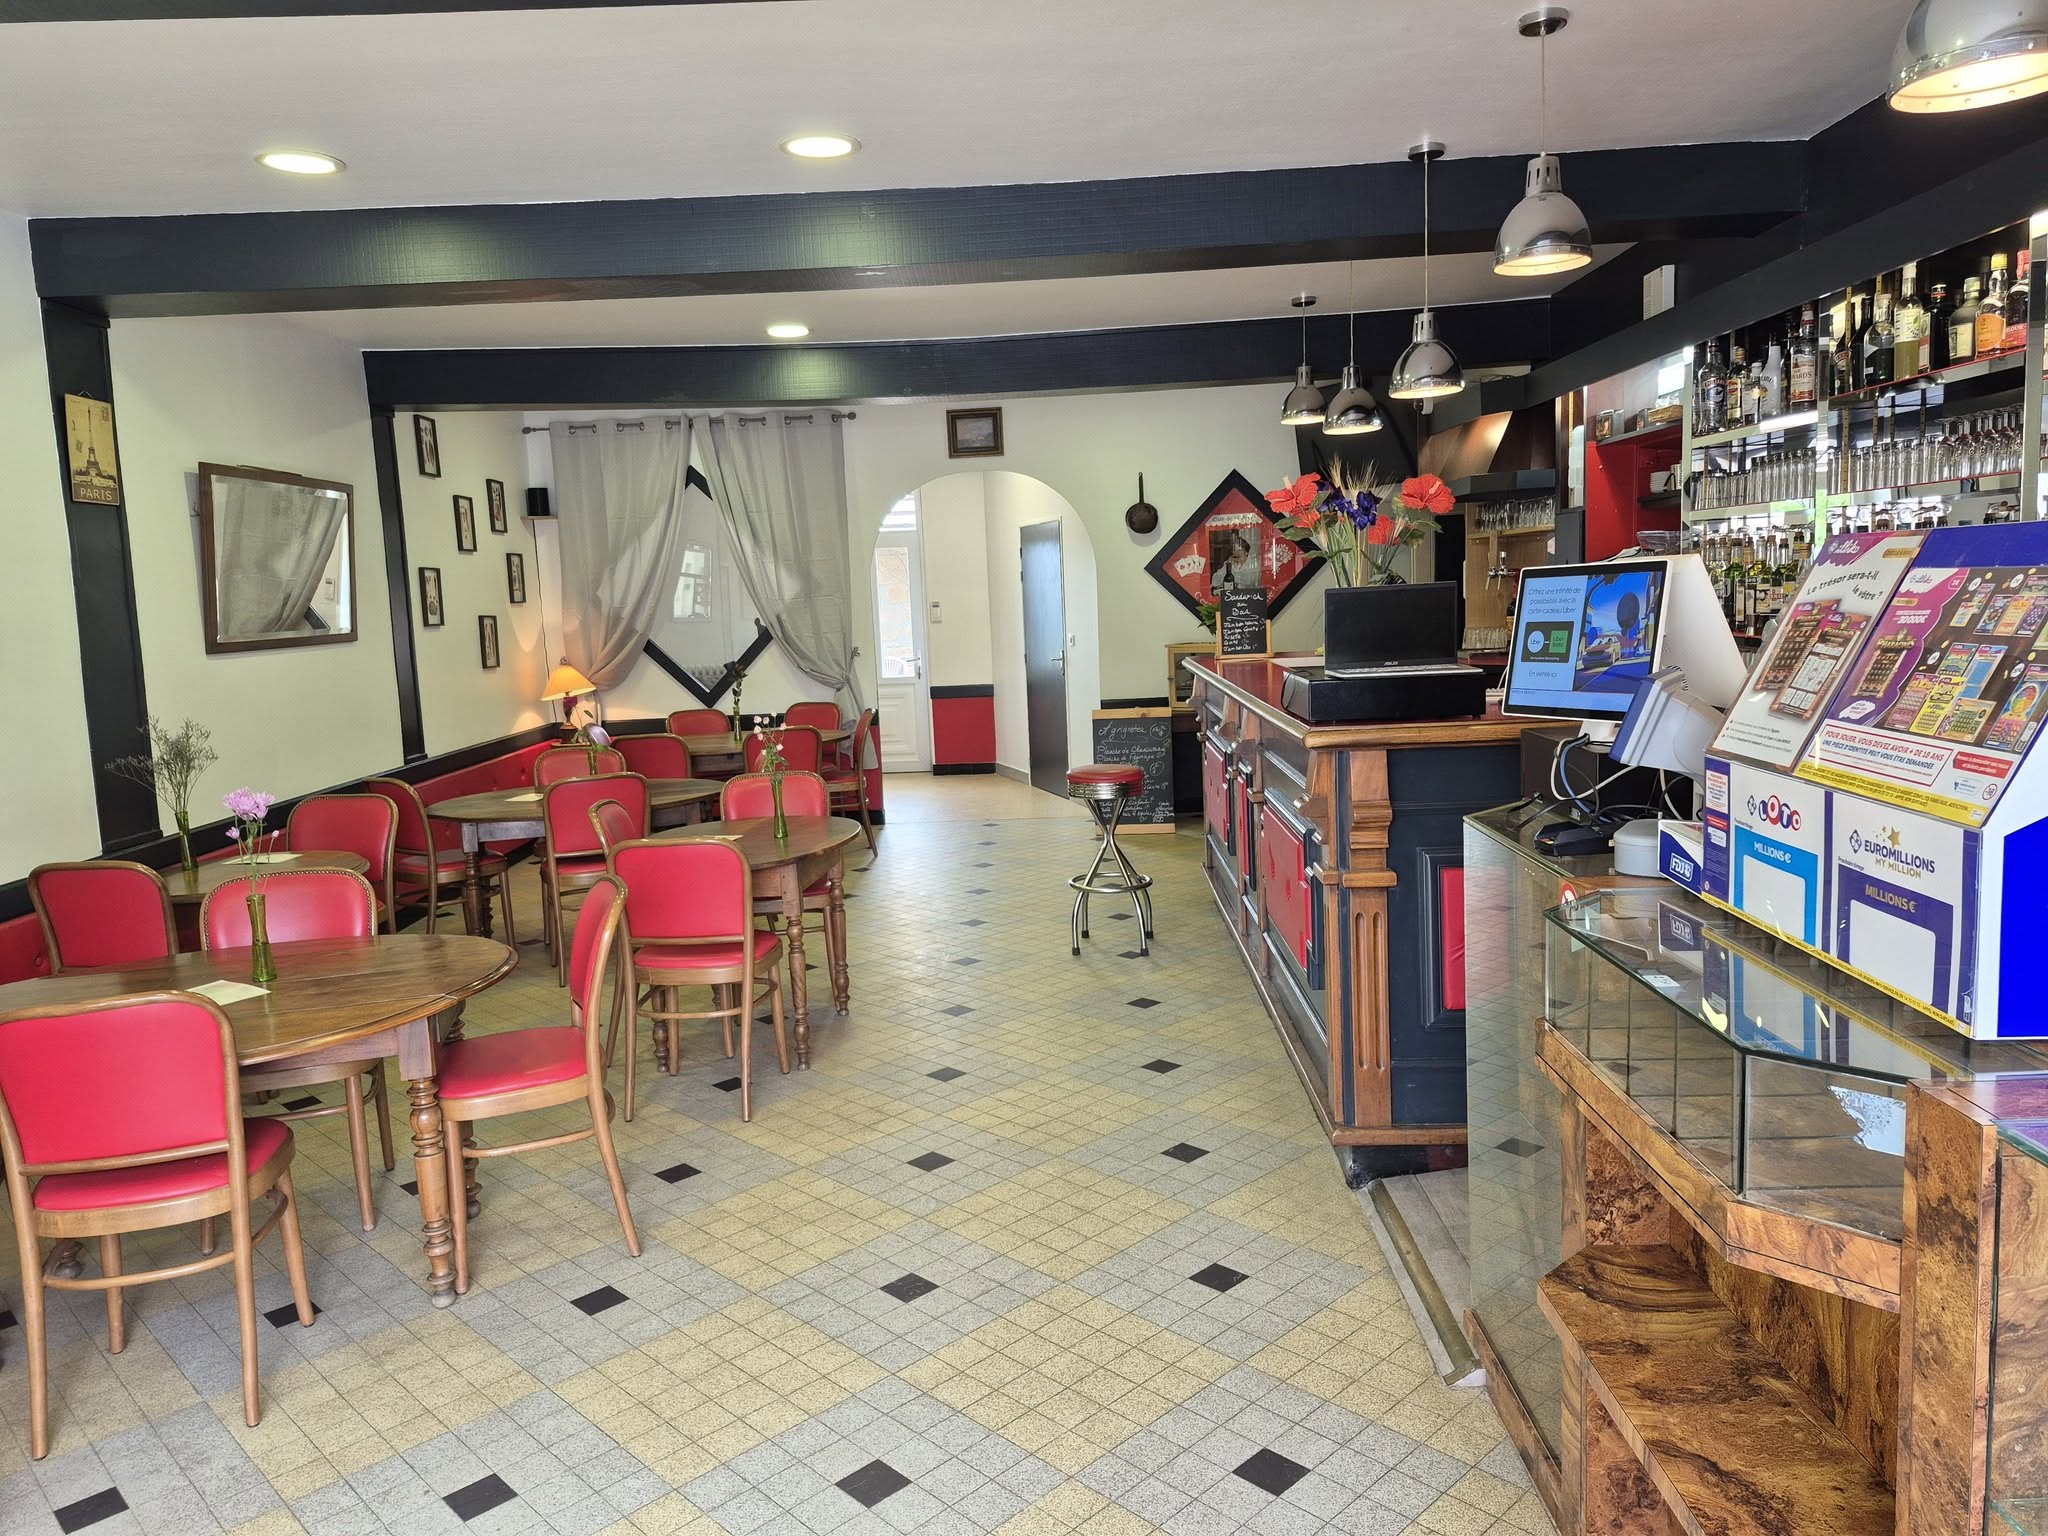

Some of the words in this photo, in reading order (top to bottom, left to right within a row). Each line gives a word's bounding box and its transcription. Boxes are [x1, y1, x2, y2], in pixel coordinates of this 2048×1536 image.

[80, 487, 113, 501] PARIS
[1224, 590, 1264, 601] Sandwich
[1825, 730, 1841, 739] POUR
[1858, 737, 1874, 746] VOUS
[1872, 740, 1891, 750] DEVEZ
[1890, 744, 1910, 753] AVOIR
[1930, 752, 1945, 761] ANS
[1880, 752, 1894, 760] VOUS
[1759, 795, 1801, 831] LOTO
[1671, 858, 1685, 873] FDJ
[1864, 839, 1935, 874] EUROMILLIONS
[1875, 857, 1886, 868] MY
[1888, 861, 1921, 879] MILLION
